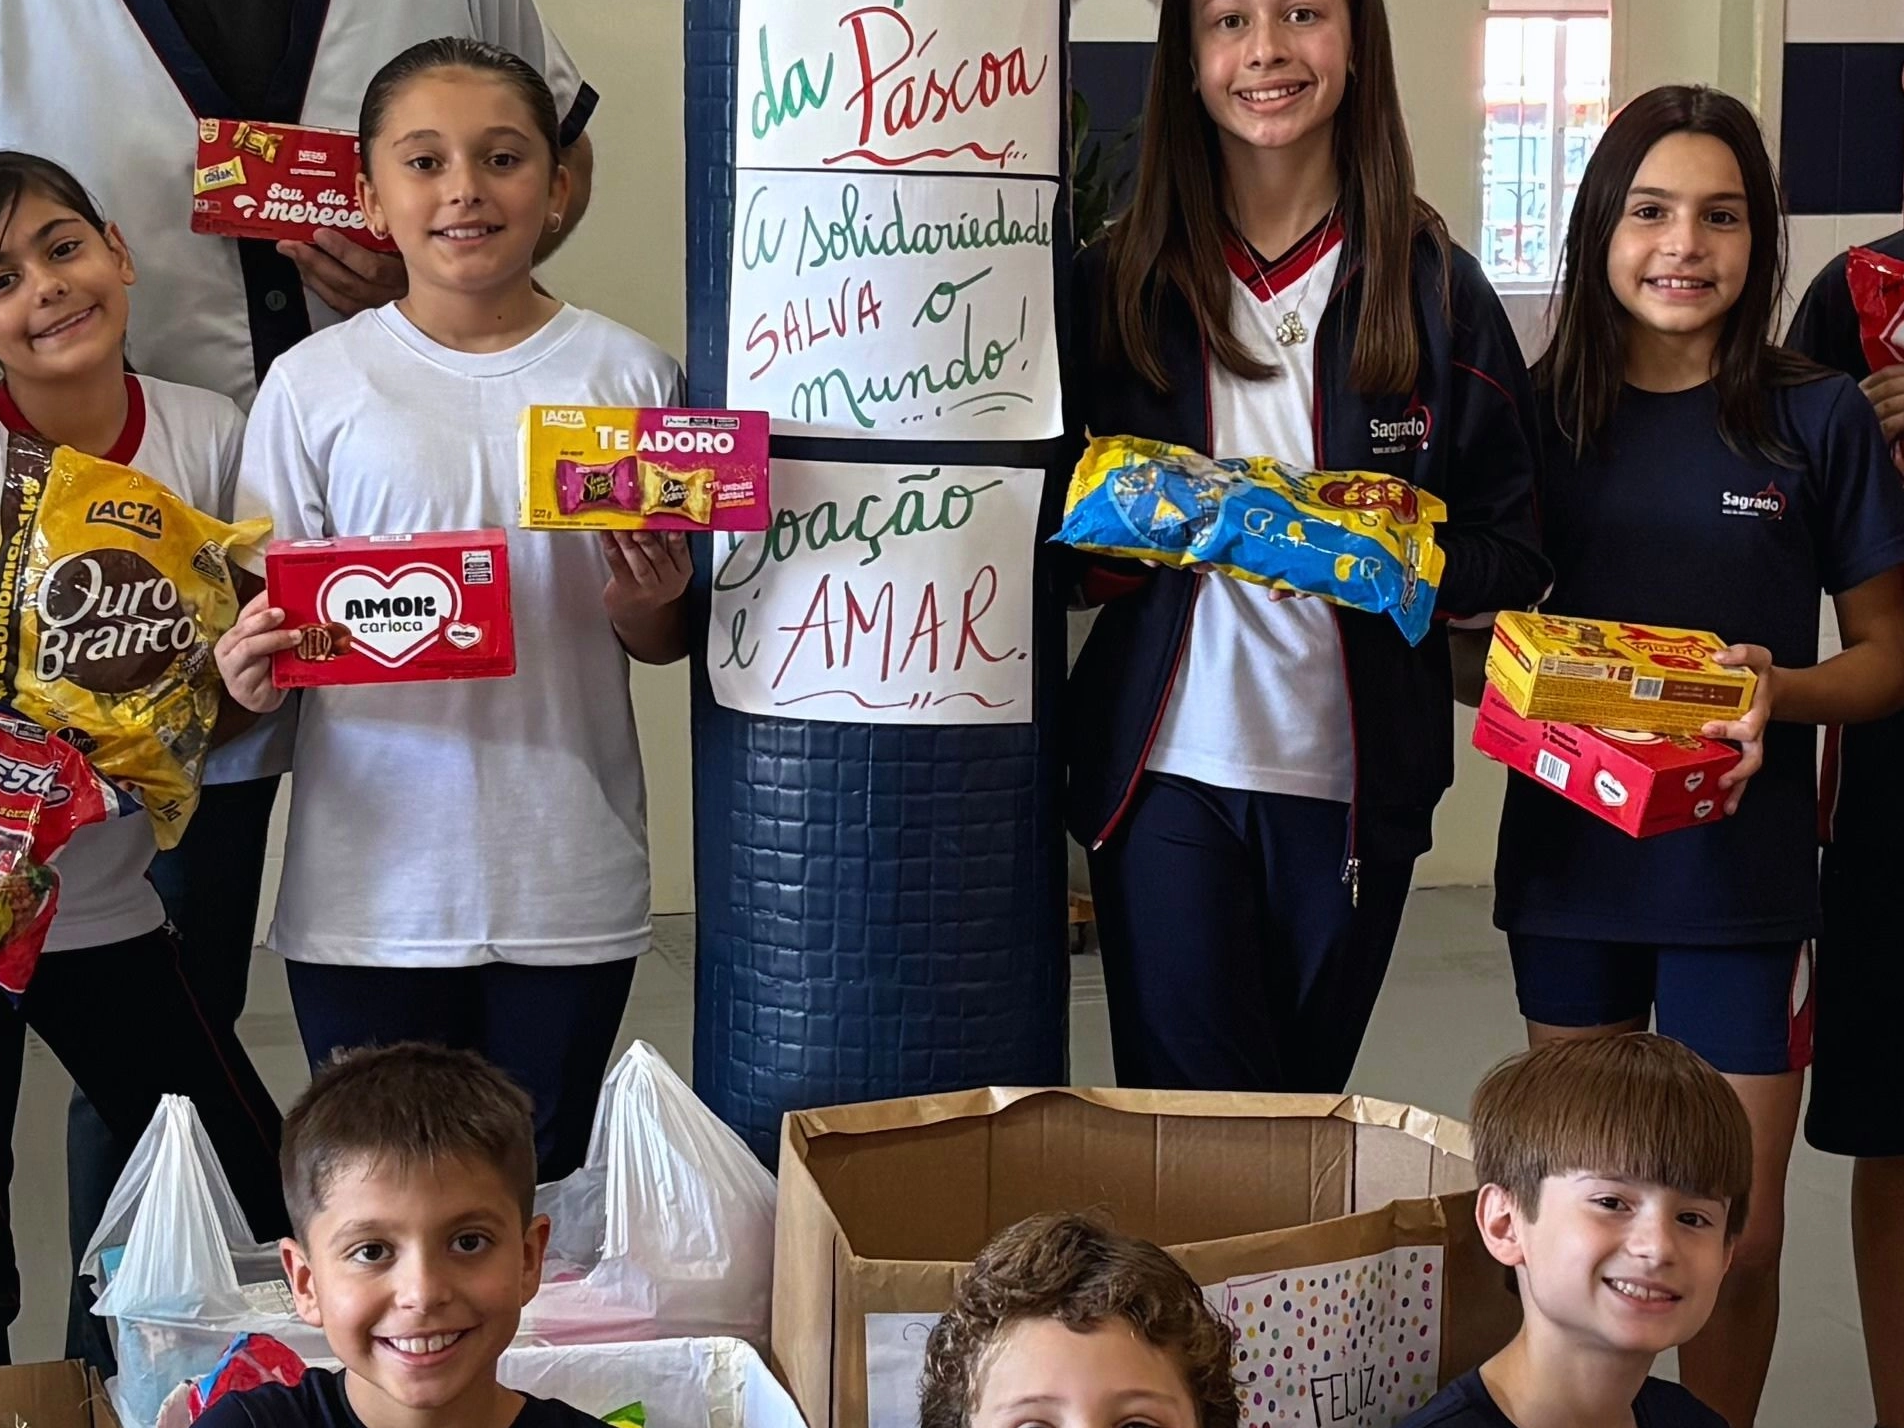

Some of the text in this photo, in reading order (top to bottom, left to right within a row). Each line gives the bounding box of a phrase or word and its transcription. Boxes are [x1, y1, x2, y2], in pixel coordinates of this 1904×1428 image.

[753, 6, 1047, 146] da Páscoa
[267, 182, 349, 206] Seu dia
[797, 183, 1052, 275] solidariedade
[746, 267, 992, 380] SALVA o
[541, 409, 587, 429] LACTA
[1370, 417, 1425, 442] Sagrado
[595, 426, 734, 454] TE ADORO
[85, 500, 163, 532] LACTA
[1722, 491, 1779, 512] Sagrado
[37, 554, 178, 628] Ouro
[345, 595, 437, 620] AMOR
[359, 620, 423, 634] carioca
[720, 586, 762, 670] é
[36, 617, 196, 682] Branco
[1311, 1364, 1376, 1428] FELIZ
